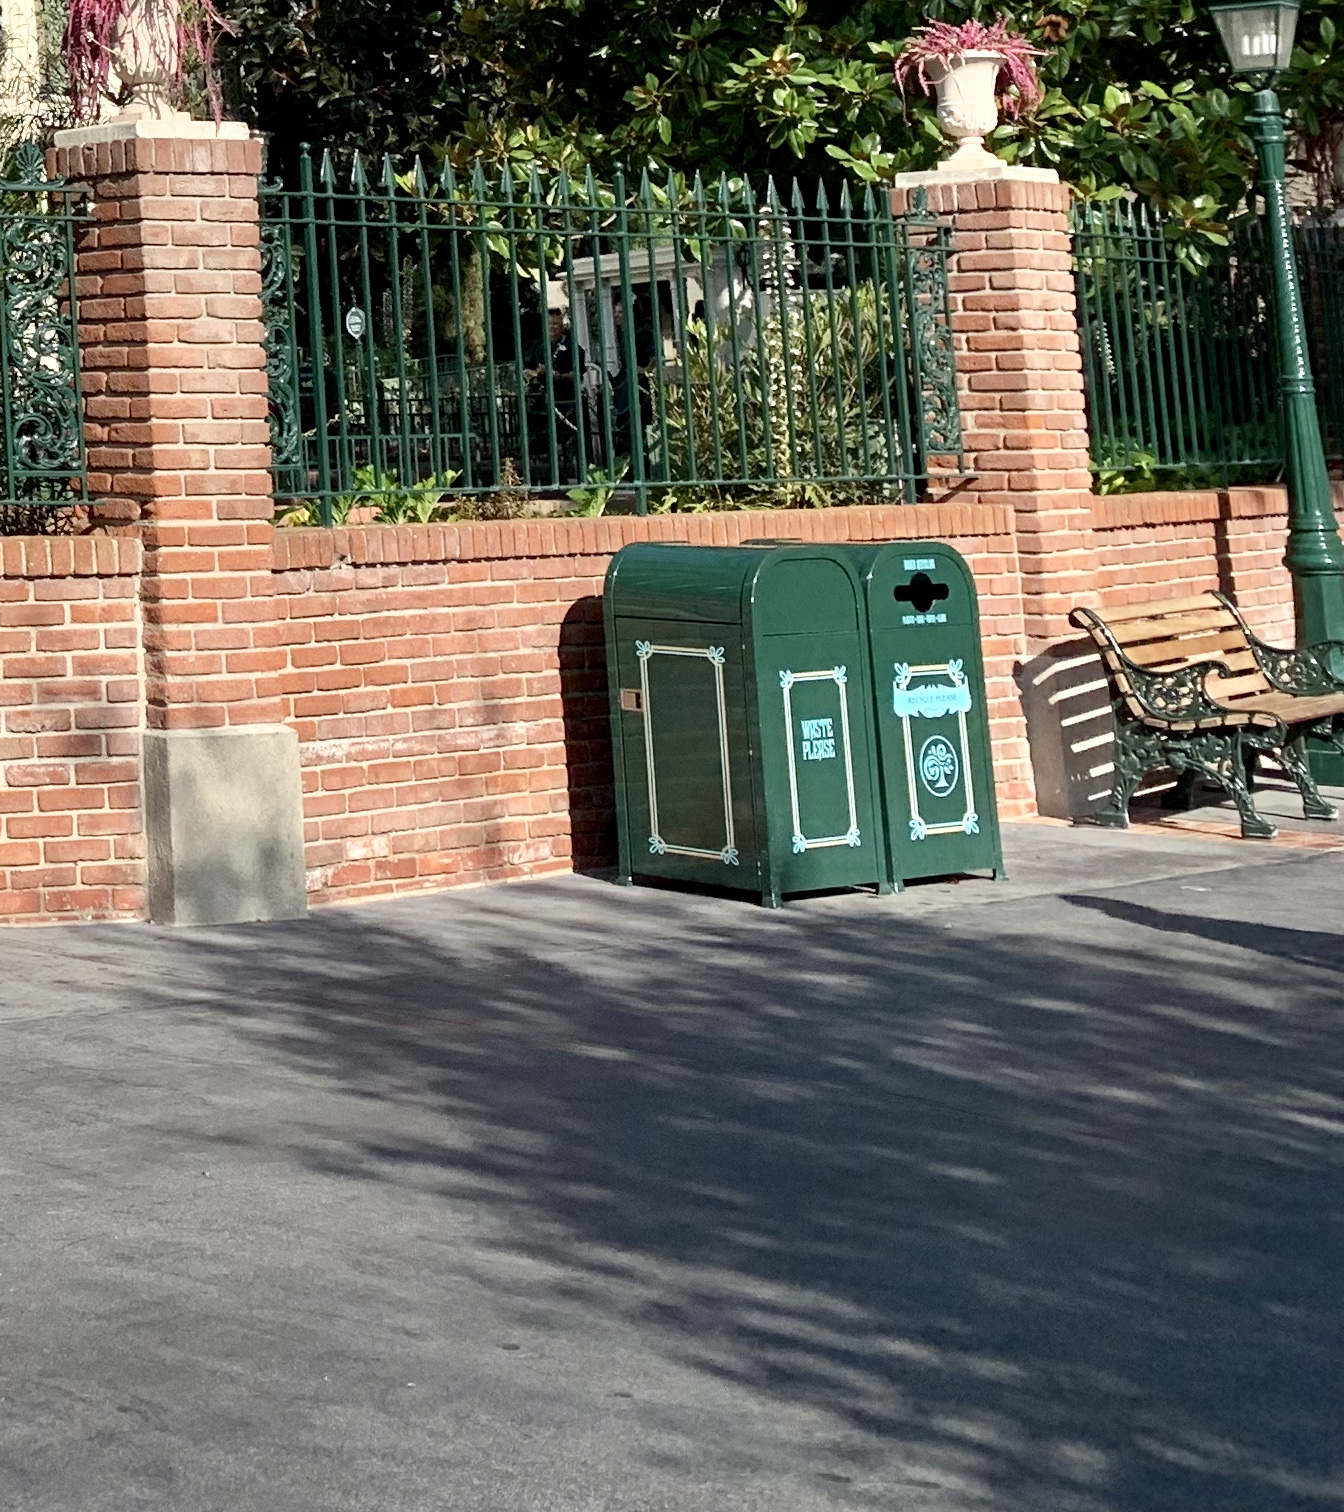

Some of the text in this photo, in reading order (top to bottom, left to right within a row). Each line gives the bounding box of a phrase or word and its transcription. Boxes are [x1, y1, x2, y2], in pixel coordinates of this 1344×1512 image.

[907, 694, 958, 704] RECYCLE PLEASE
[800, 718, 834, 740] WASTE
[802, 738, 836, 762] PLEASE
